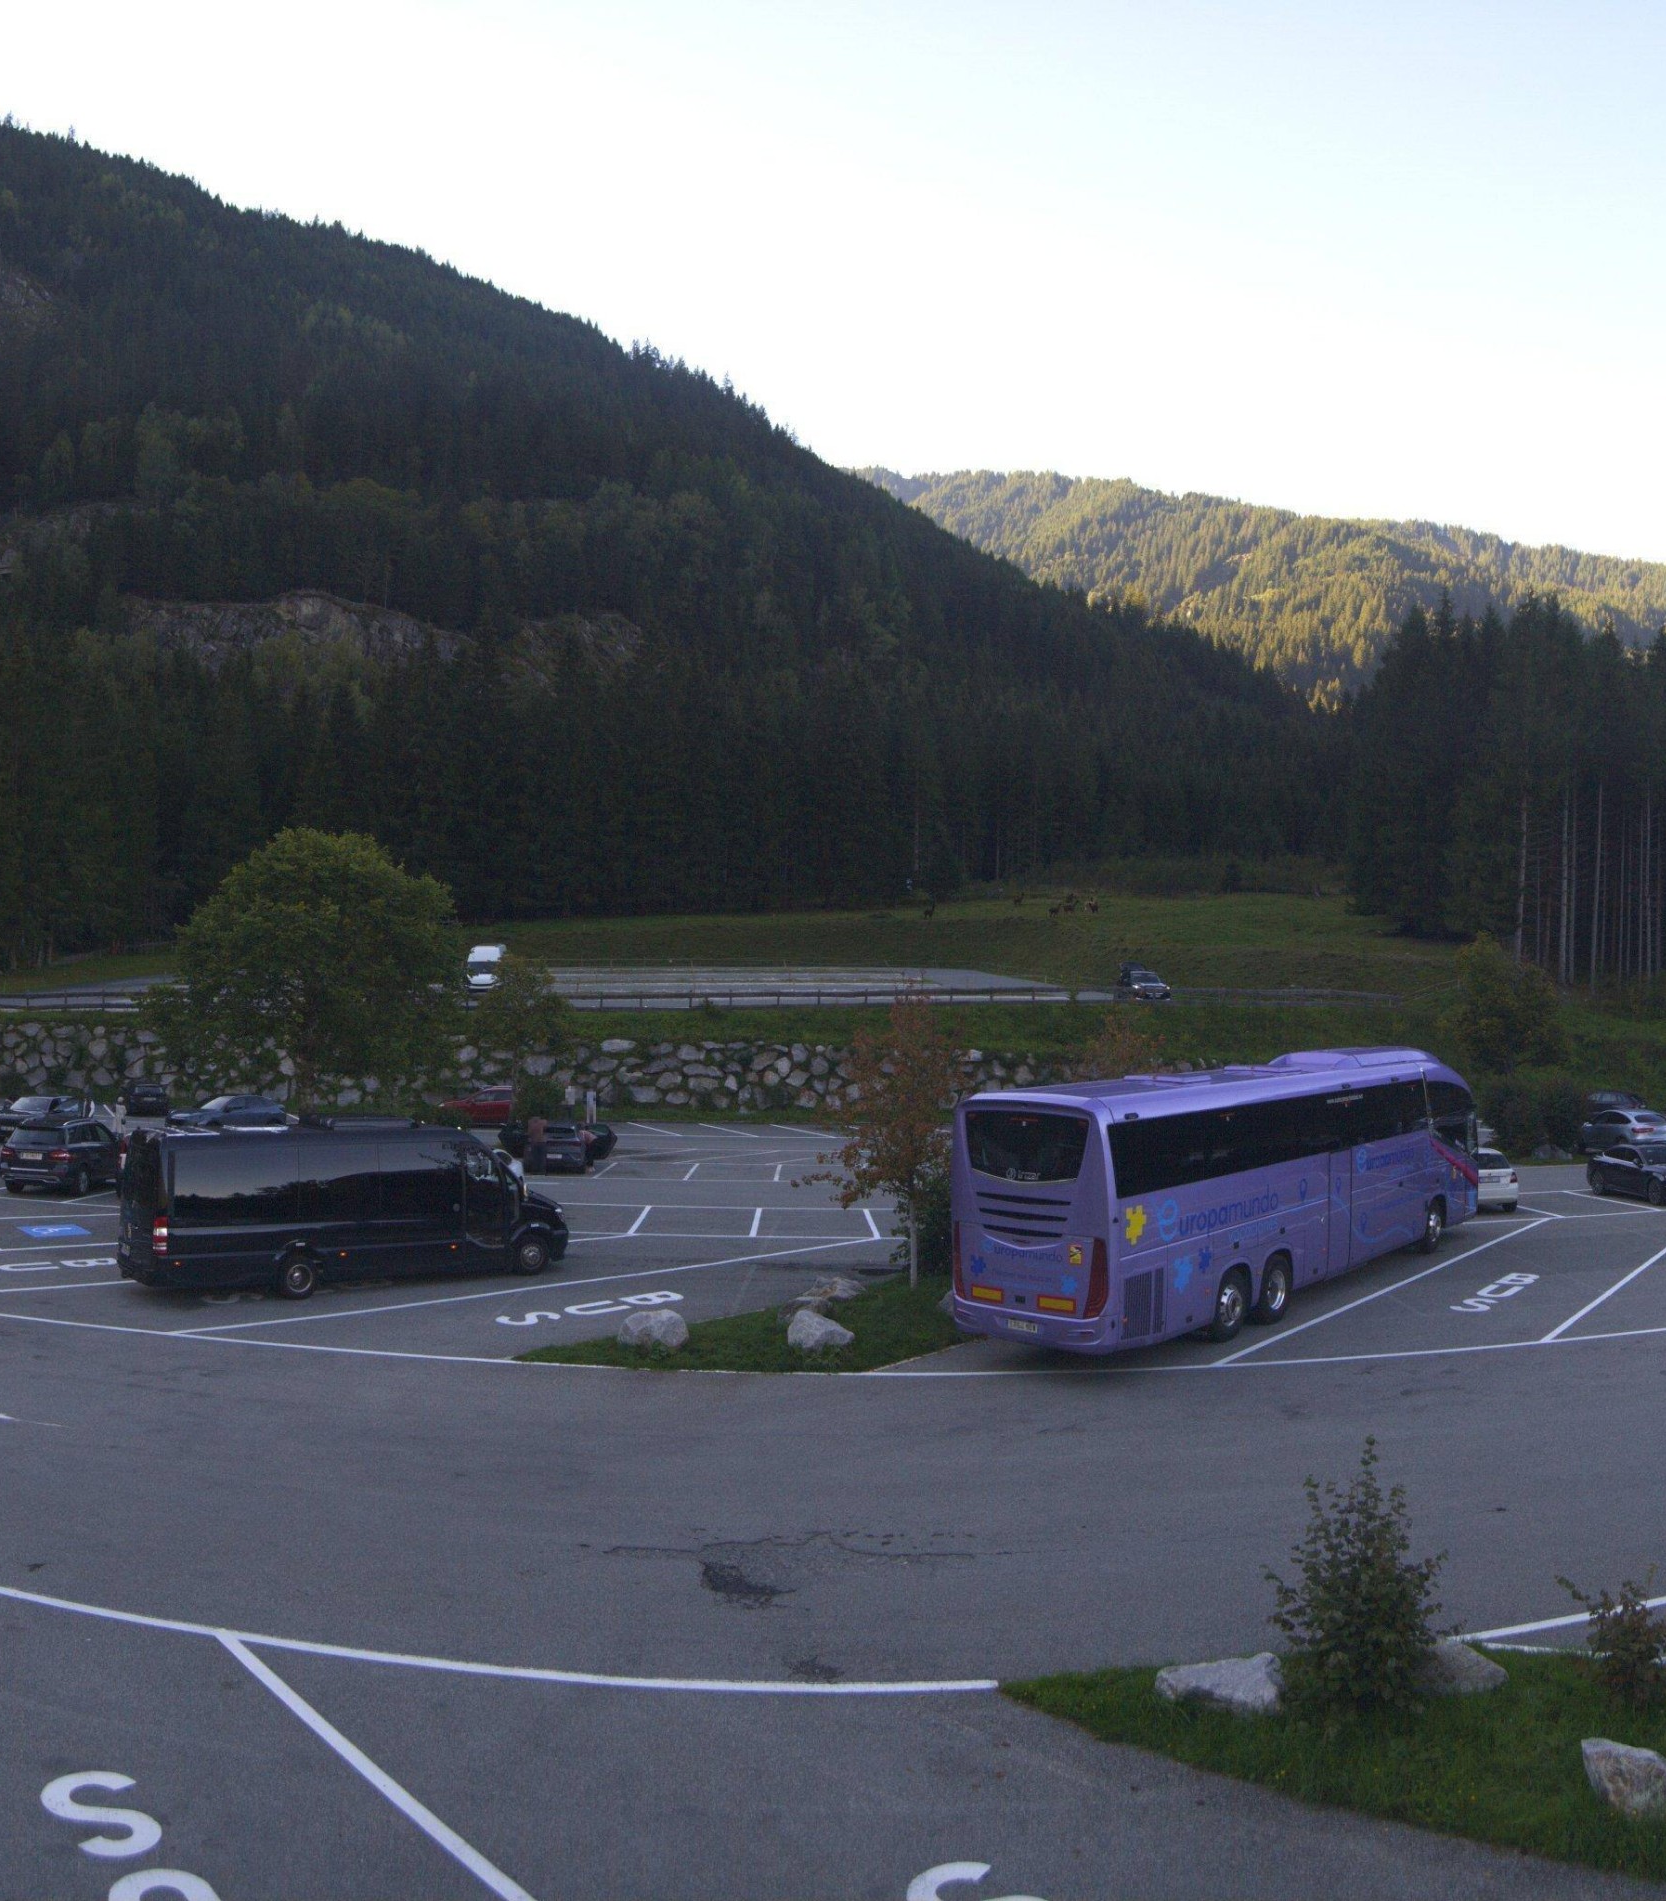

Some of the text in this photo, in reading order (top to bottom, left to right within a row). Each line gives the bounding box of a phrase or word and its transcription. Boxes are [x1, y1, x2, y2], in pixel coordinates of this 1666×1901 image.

[1156, 1185, 1279, 1242] europamundo
[495, 1290, 684, 1326] BUS
[1449, 1272, 1540, 1312] BUS
